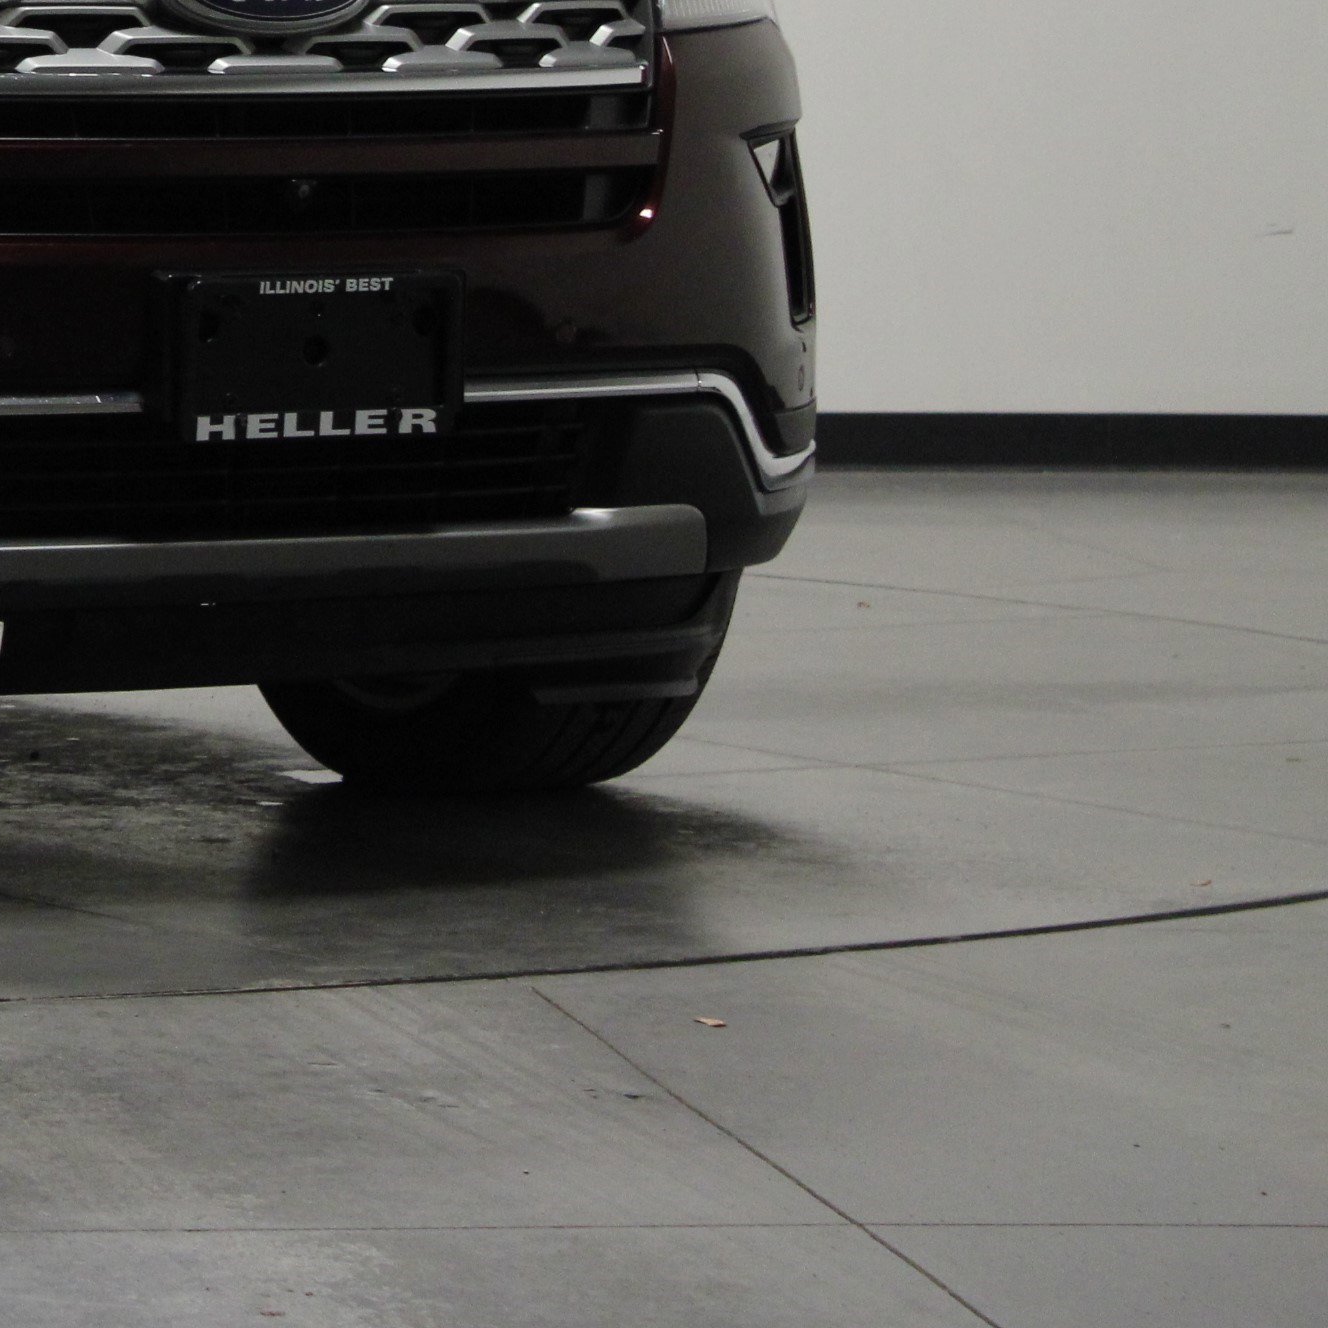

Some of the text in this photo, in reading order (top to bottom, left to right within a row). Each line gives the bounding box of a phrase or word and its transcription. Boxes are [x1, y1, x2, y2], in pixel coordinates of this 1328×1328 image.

[259, 276, 394, 295] ILLINOIS' BEST
[195, 407, 438, 442] HELLER
